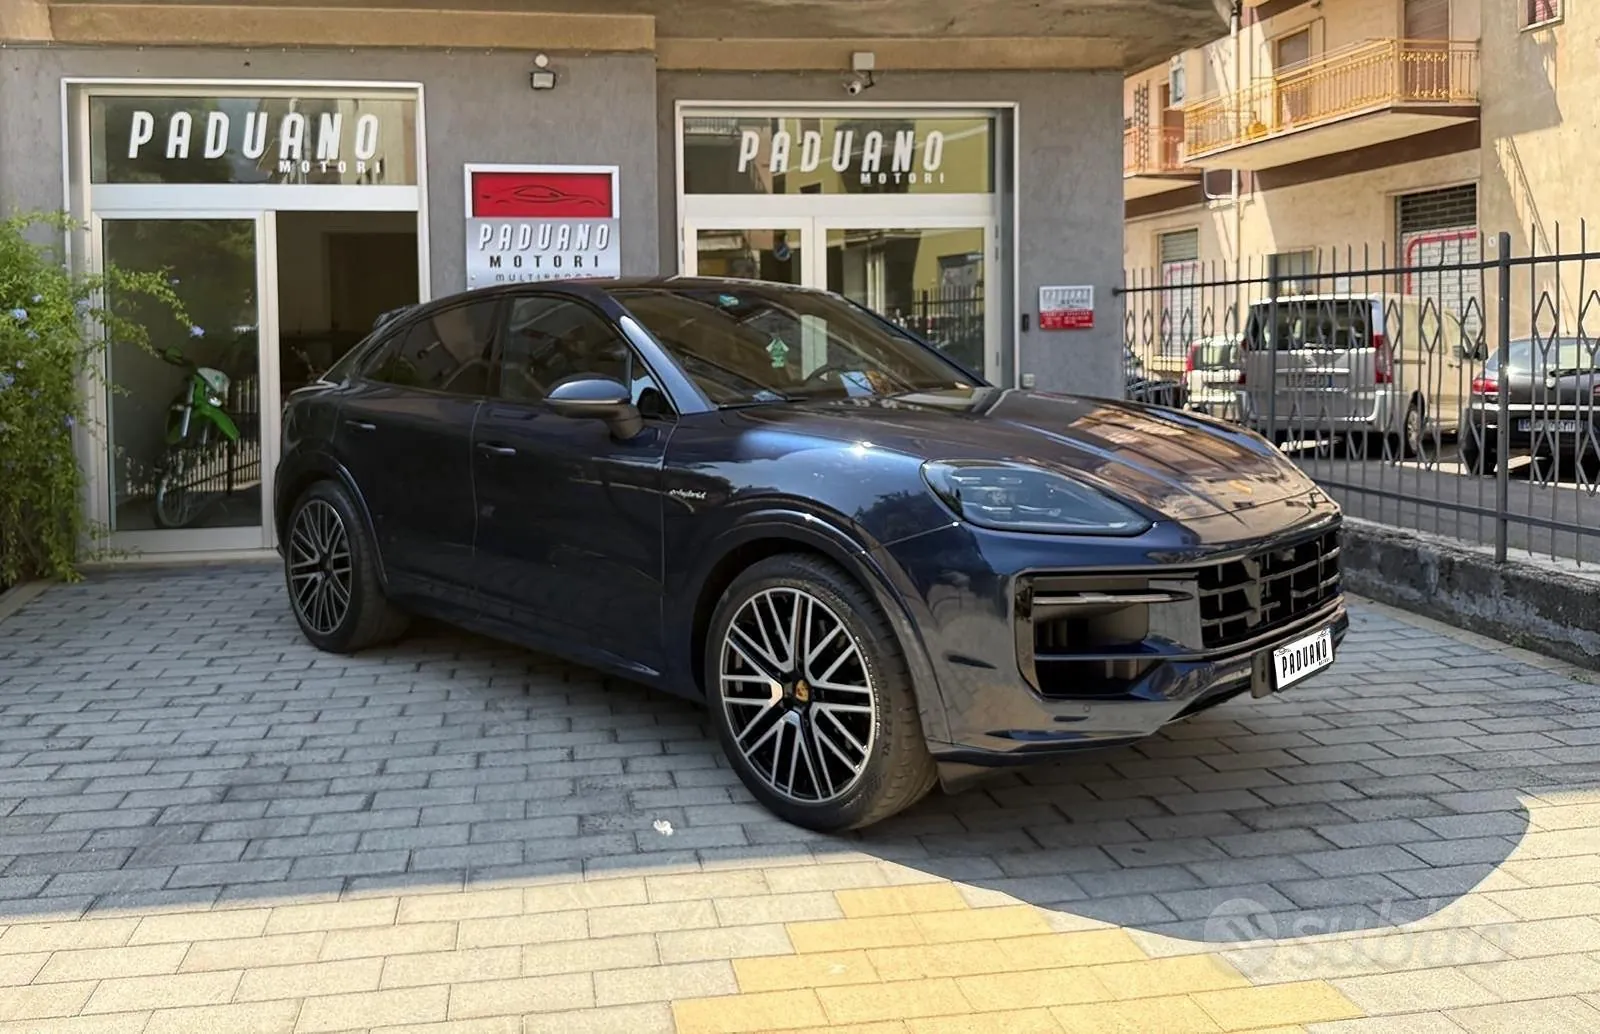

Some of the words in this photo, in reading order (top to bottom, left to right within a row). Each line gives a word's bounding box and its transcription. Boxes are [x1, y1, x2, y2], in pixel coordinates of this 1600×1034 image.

[128, 111, 379, 159] PADUANO
[738, 130, 944, 173] PADUANO
[278, 160, 382, 174] MOTORI
[860, 172, 945, 184] MOTORI
[479, 223, 610, 251] PADUANO
[490, 255, 599, 268] MOTORI
[1282, 638, 1327, 678] PADUANO
